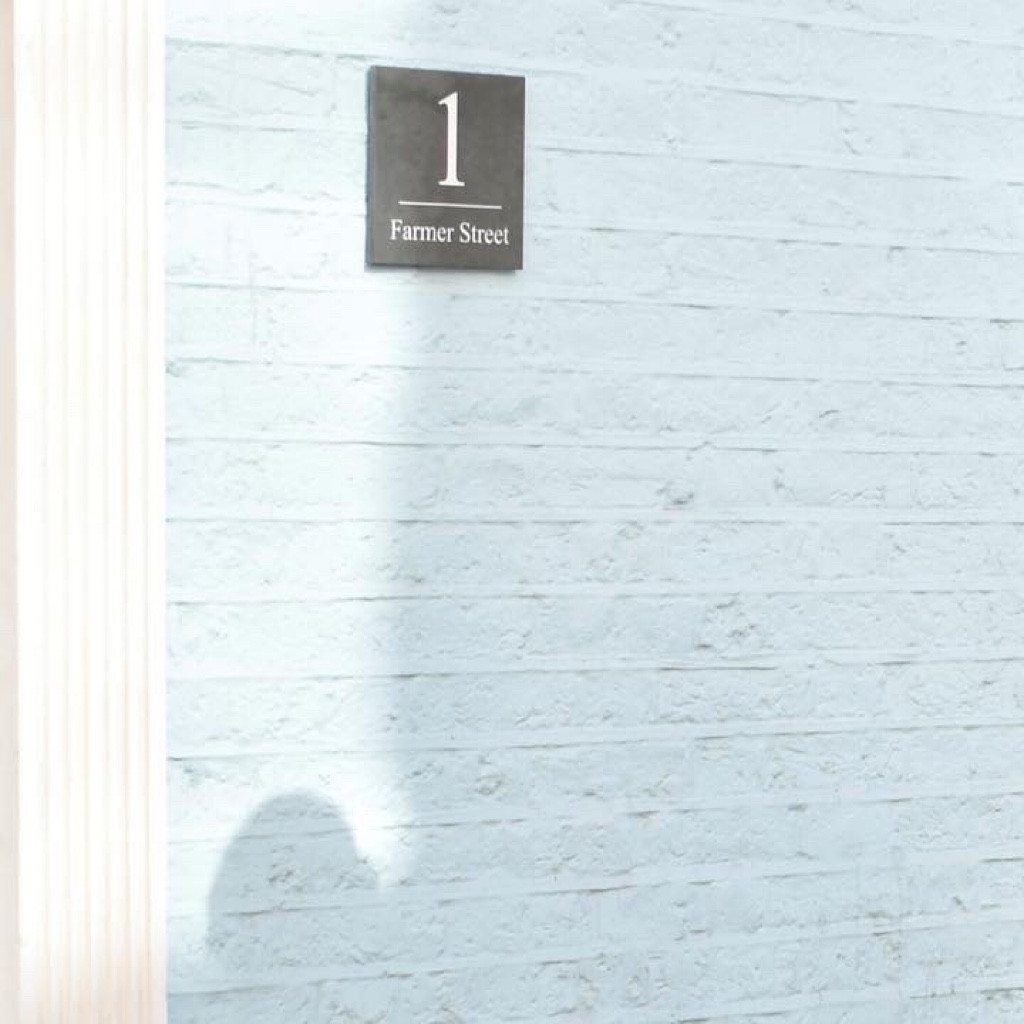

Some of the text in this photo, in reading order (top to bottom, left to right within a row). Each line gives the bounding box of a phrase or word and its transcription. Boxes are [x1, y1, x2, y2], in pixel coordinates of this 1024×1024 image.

[438, 91, 465, 187] 1
[390, 218, 510, 245] Farmer Street
